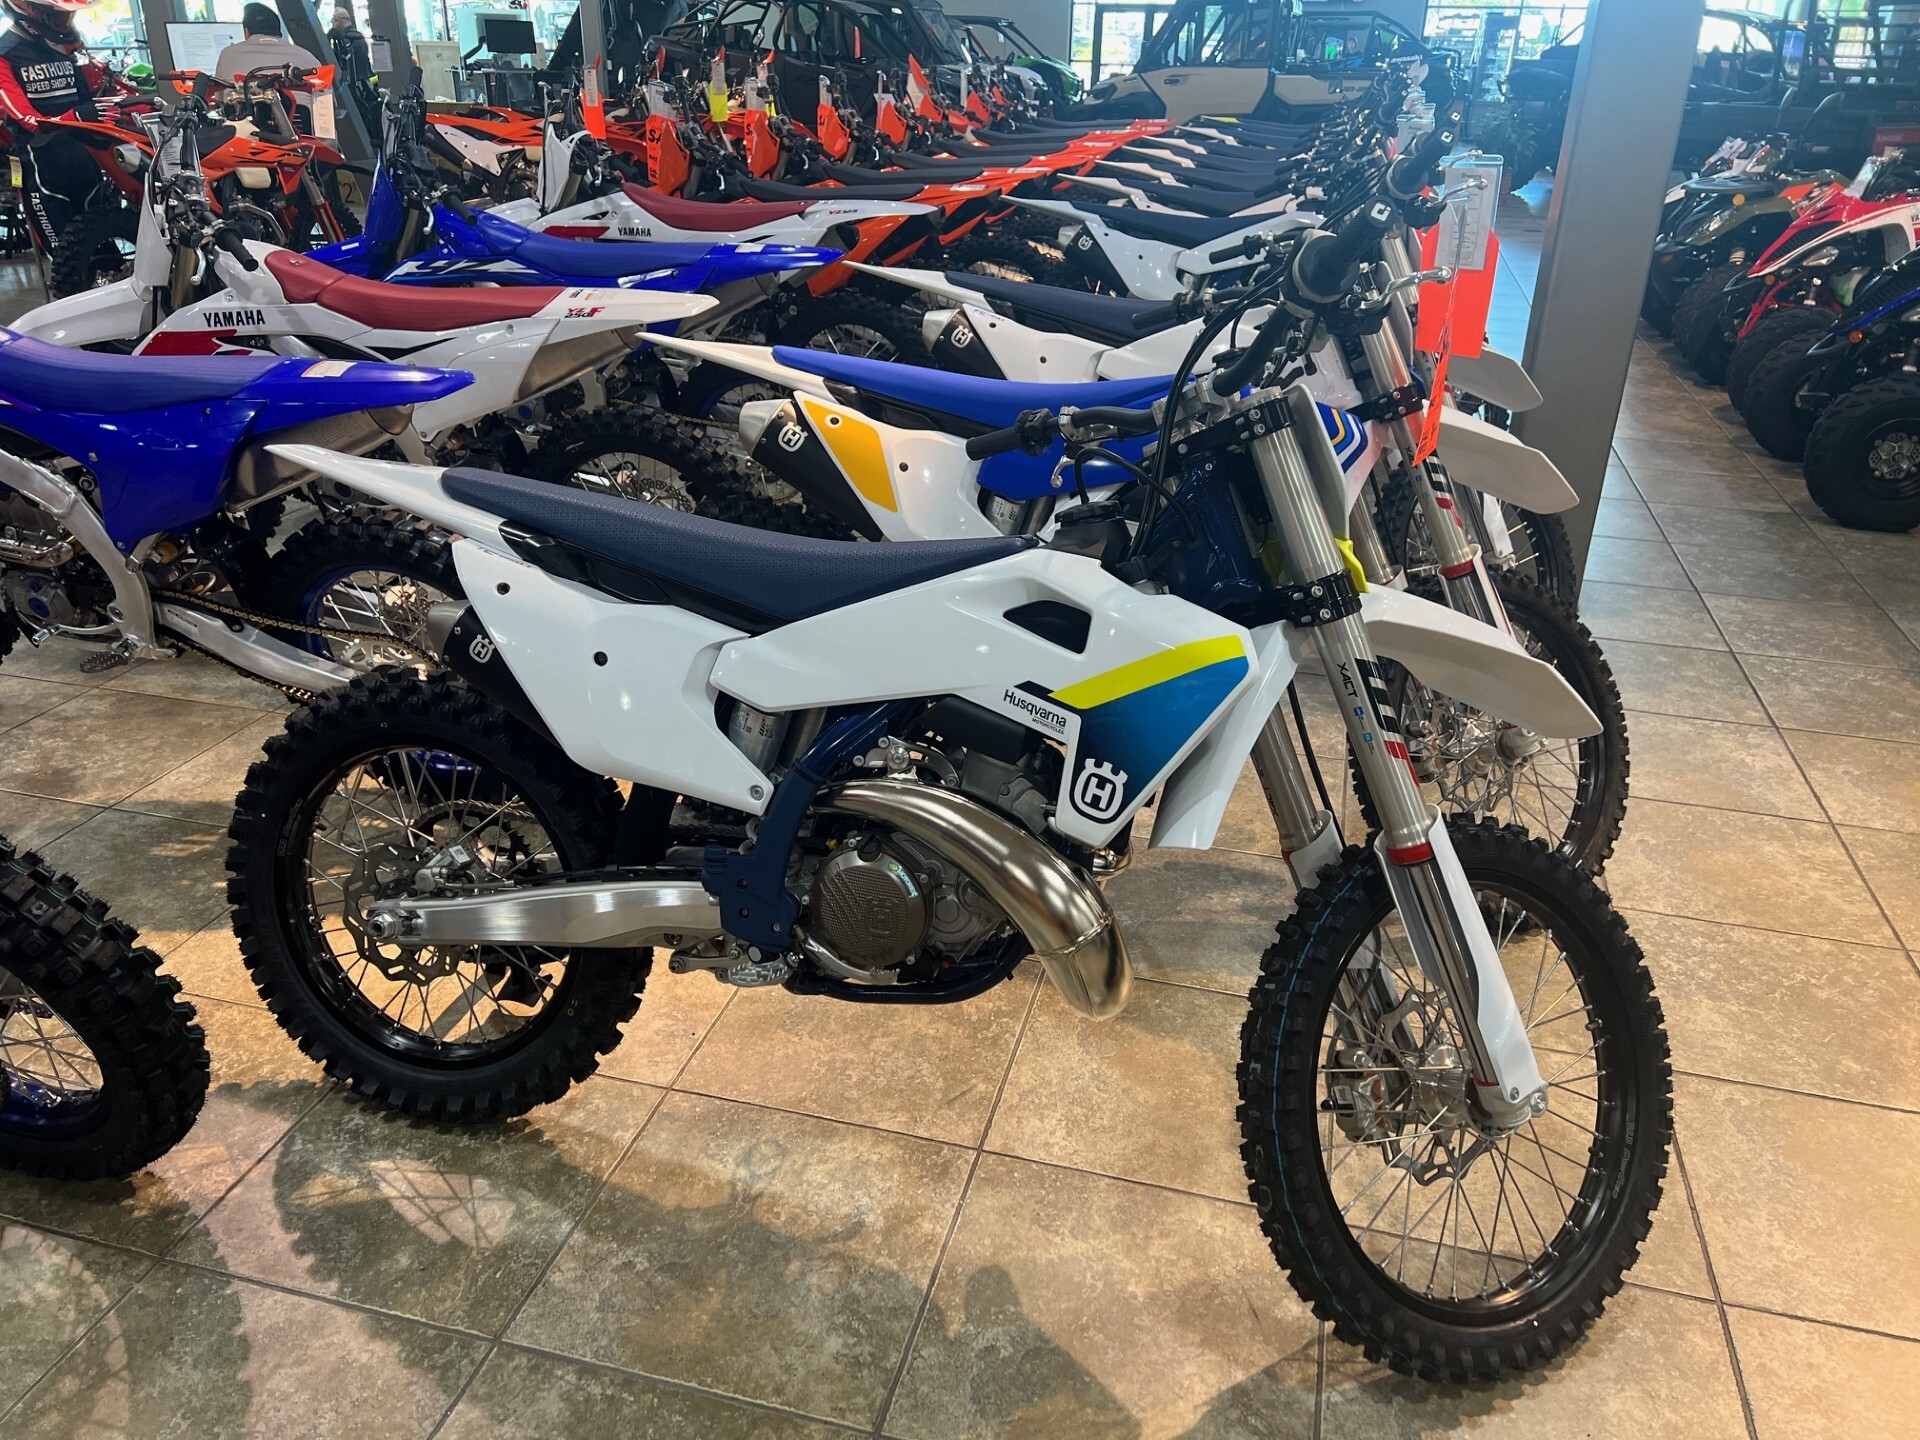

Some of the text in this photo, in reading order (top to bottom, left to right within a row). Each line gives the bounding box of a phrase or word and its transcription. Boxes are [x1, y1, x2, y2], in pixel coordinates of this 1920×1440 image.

[26, 78, 67, 92] SPEED SHOP
[30, 192, 60, 249] FASTHOUSE
[618, 226, 652, 238] YAMAHA
[203, 309, 266, 328] YAMAHA
[1336, 661, 1359, 698] XACT
[1003, 688, 1067, 728] Husqvarna
[1031, 717, 1065, 735] MOTORCYCLES
